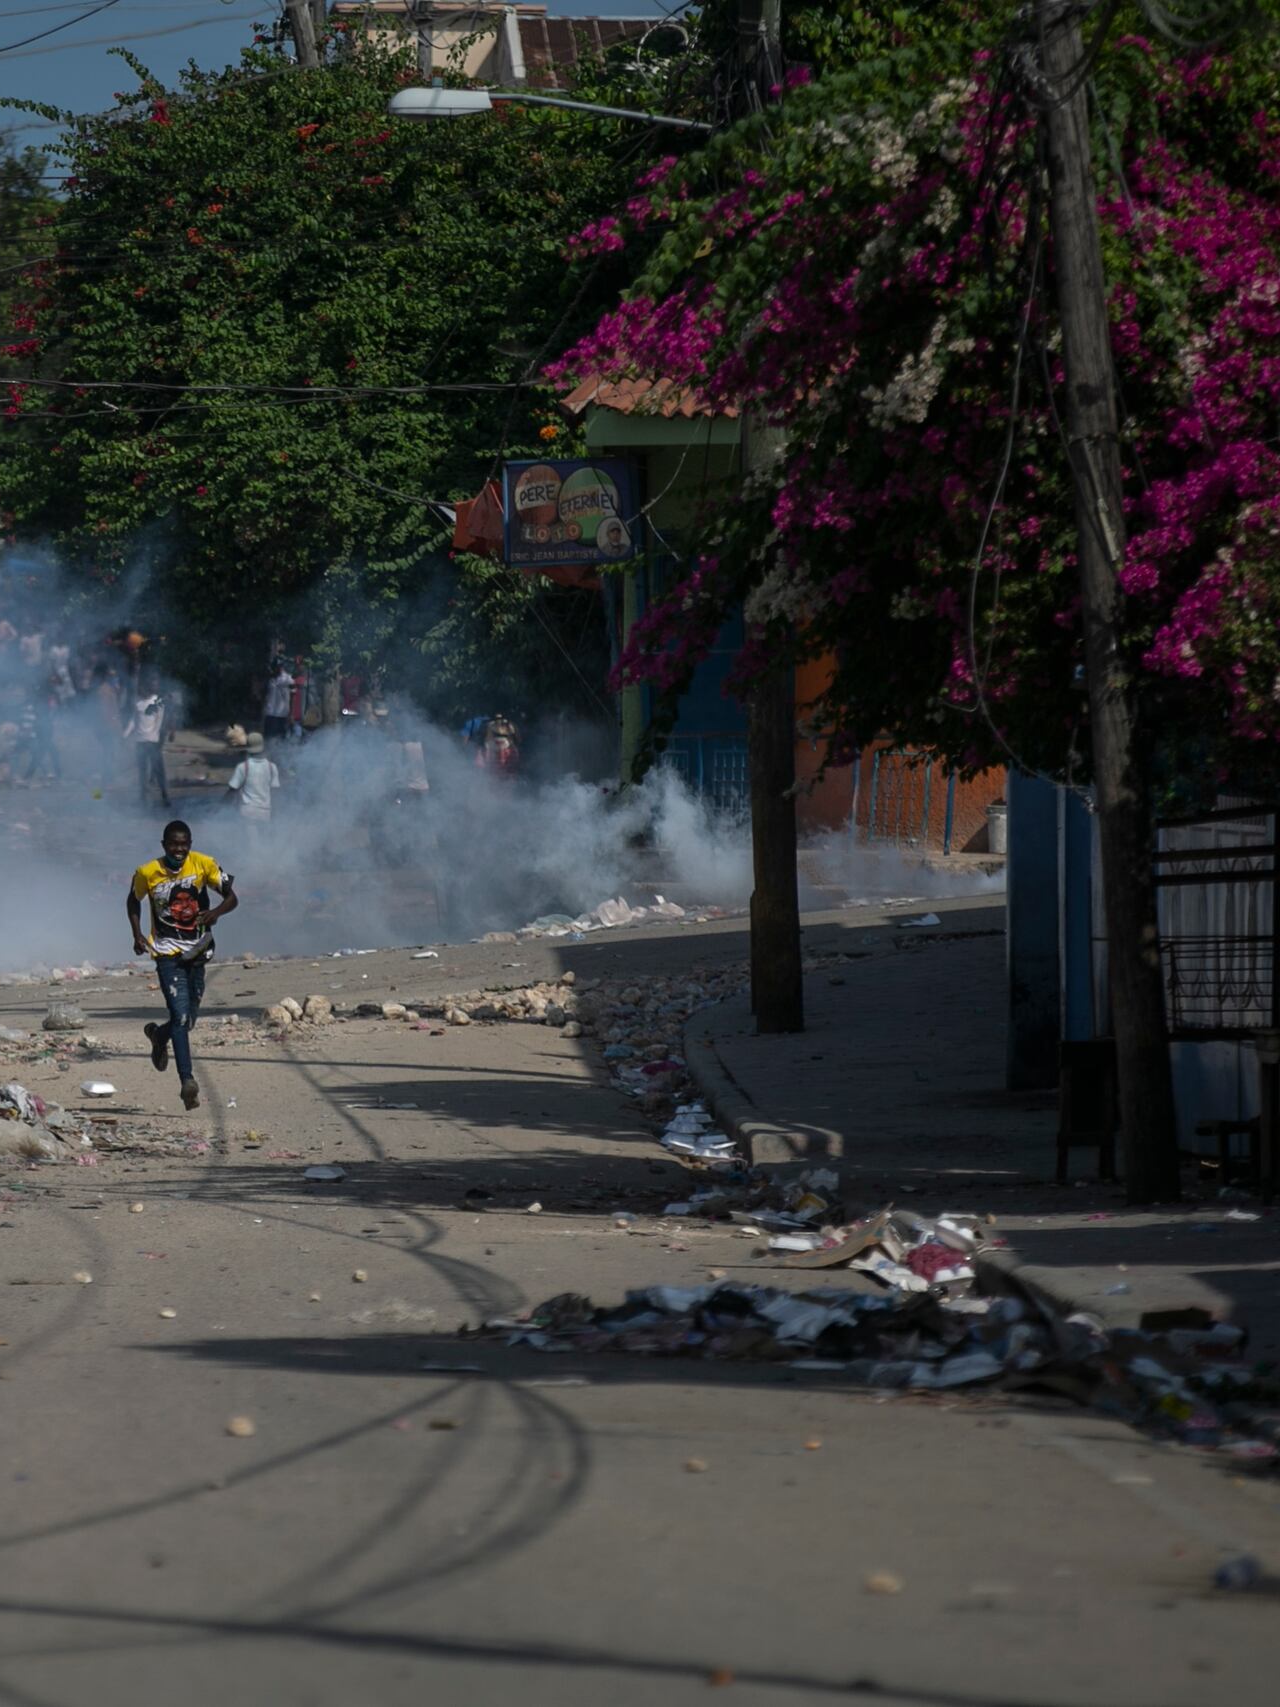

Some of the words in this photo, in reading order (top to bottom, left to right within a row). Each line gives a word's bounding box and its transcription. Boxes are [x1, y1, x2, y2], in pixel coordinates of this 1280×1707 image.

[520, 485, 557, 505] PERE
[532, 552, 555, 561] JEAN
[557, 550, 600, 560] BAPTISTE
